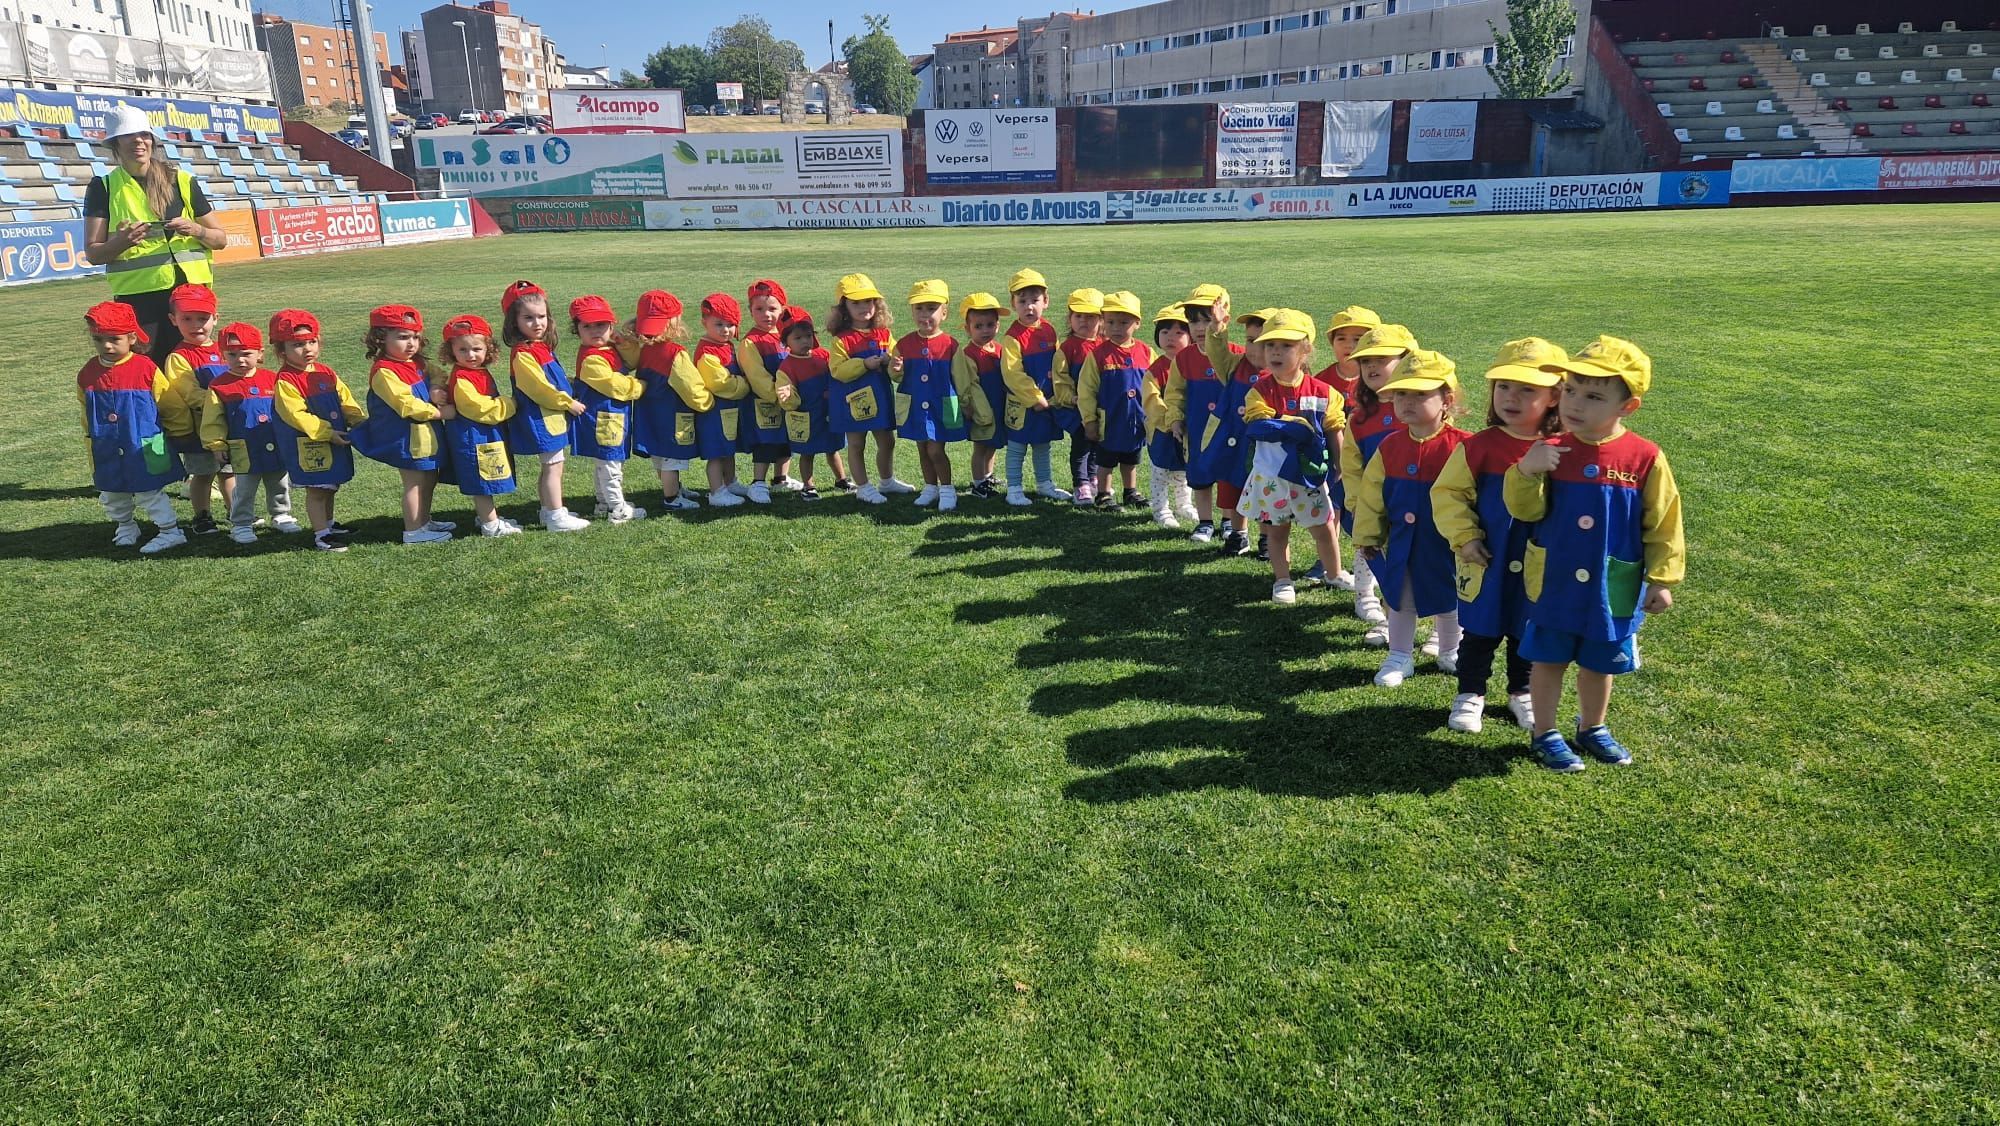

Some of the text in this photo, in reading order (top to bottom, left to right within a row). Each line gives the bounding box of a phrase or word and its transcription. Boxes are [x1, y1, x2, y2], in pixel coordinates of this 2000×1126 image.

[577, 94, 659, 115] Alcampo
[995, 114, 1049, 125] Vepersa
[1224, 113, 1295, 128] Jacinto Vidal
[706, 147, 784, 165] PLAGAL
[937, 154, 989, 165] Vepersa
[1222, 159, 1291, 168] 986 50 74 64
[1245, 168, 1257, 176] 72
[1262, 168, 1274, 176] 73
[1899, 157, 1976, 177] CHATARRERÍA
[442, 171, 539, 183] UMINIOS Y PVC
[1364, 184, 1478, 201] LA JUNQUERA
[1550, 178, 1644, 197] DEPUTACIÓN
[516, 201, 591, 210] CONSTRUCCIONES
[1134, 190, 1206, 206] Sigaltec
[1550, 195, 1643, 209] PONTEVEDRA
[776, 201, 797, 215] M.
[918, 204, 936, 212] S.L.
[942, 199, 1101, 223] Diario de Arousa
[327, 206, 376, 236] acebo
[387, 216, 436, 232] tvmac
[860, 217, 873, 226] DE
[876, 217, 926, 226] SEGUROS
[2, 226, 53, 238] DEPORTES
[1606, 468, 1639, 483] ENZO
